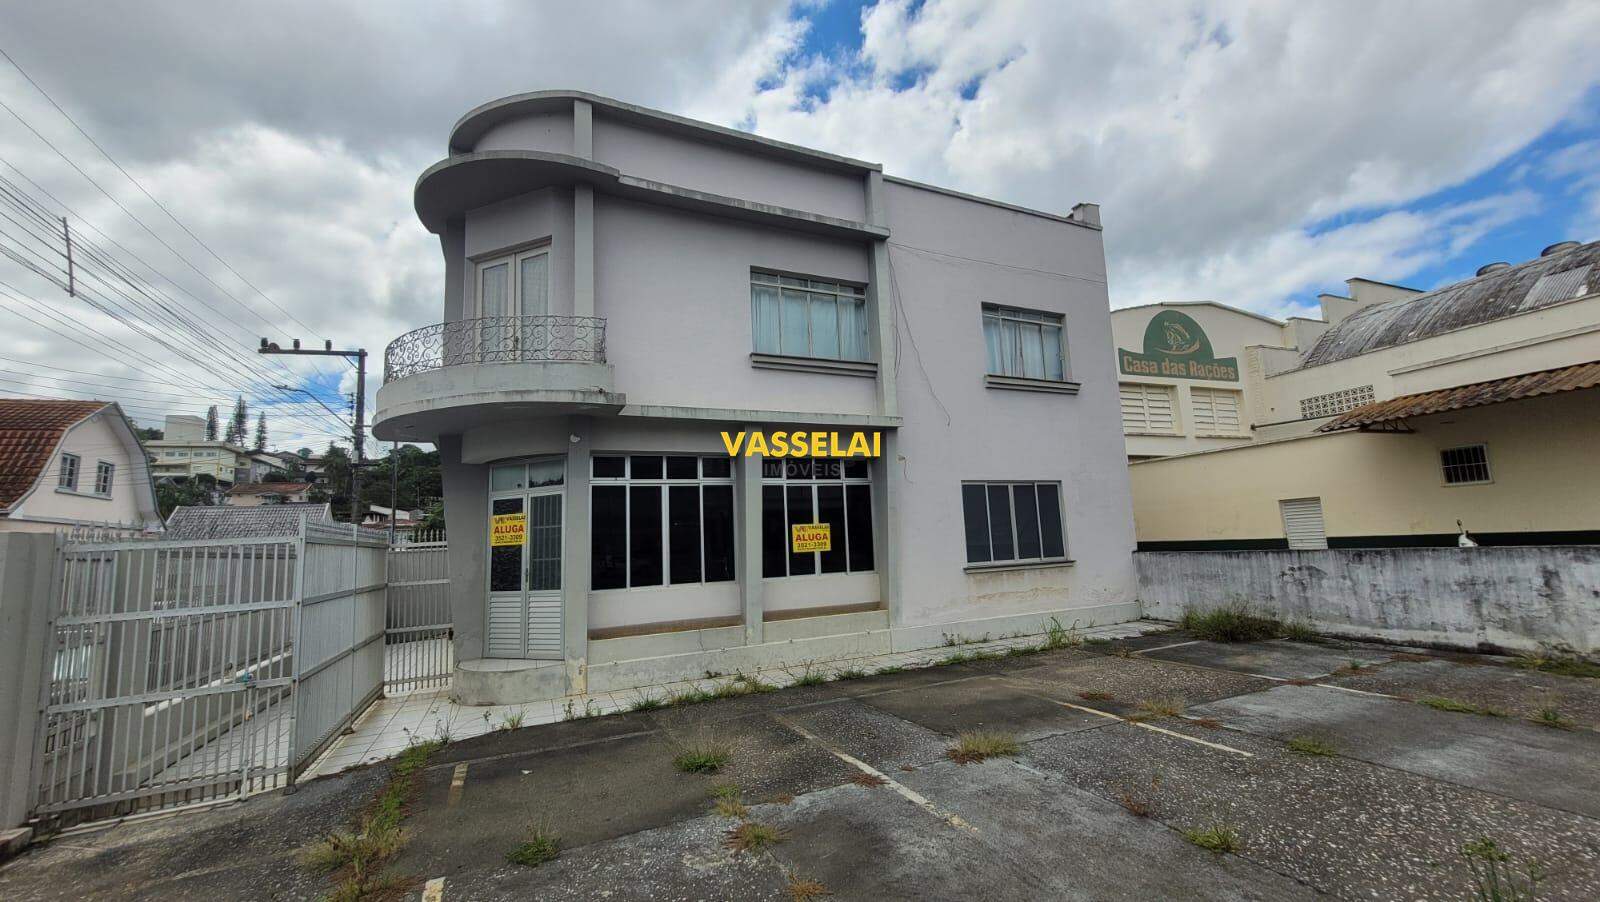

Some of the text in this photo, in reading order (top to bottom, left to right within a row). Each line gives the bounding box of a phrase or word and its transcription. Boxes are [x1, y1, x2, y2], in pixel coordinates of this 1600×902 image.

[1123, 355, 1236, 380] Casa das Rações
[494, 525, 524, 534] ALUGA
[795, 533, 828, 542] ALUGA
